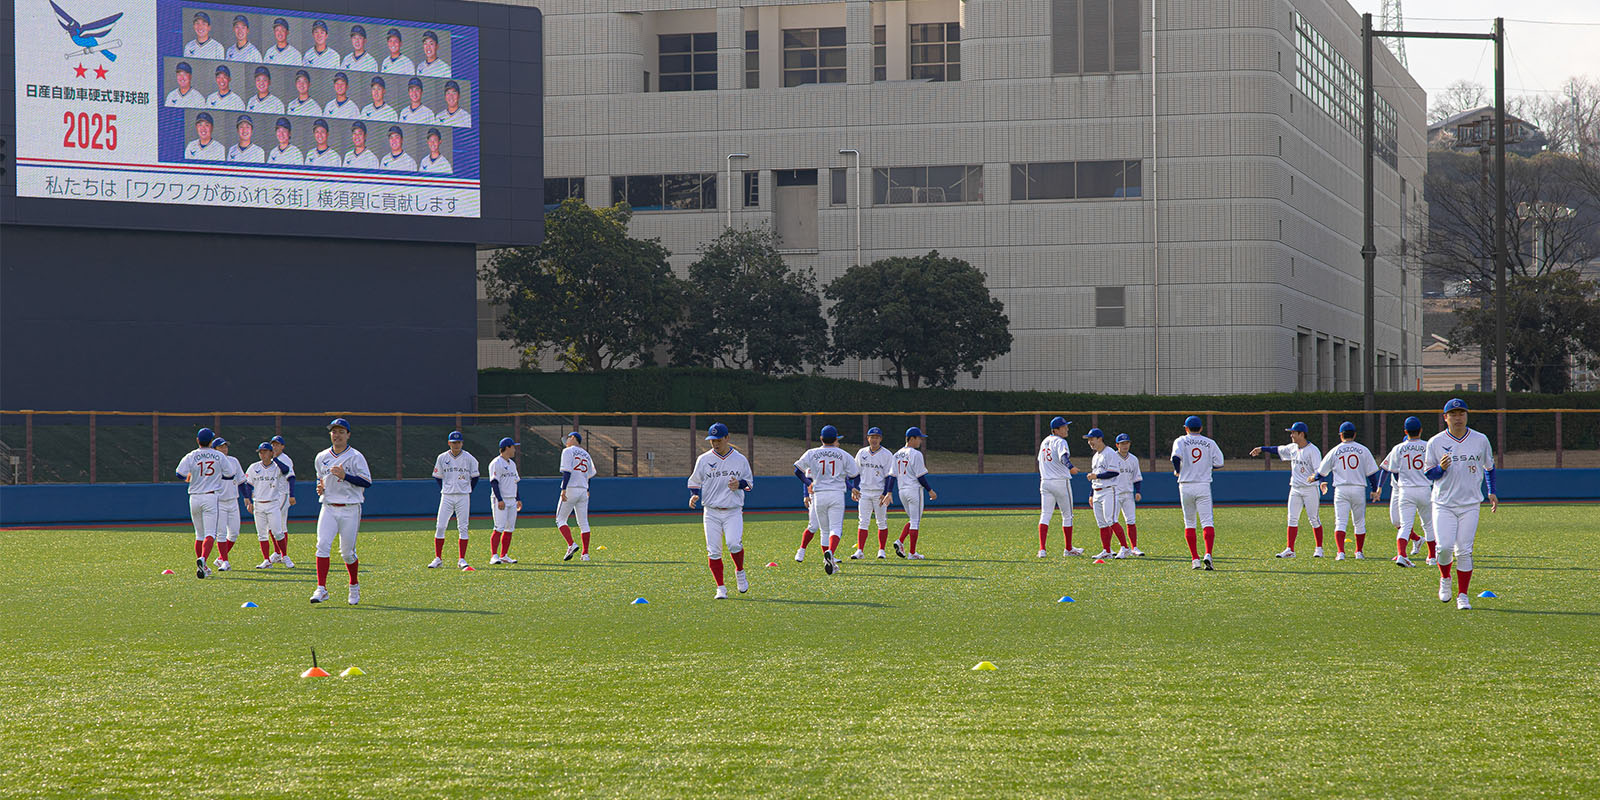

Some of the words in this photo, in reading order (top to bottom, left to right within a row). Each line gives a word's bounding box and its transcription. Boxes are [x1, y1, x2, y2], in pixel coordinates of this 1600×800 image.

[26, 84, 149, 104] 日産自動車硬式野球部
[63, 111, 117, 151] 2025
[45, 175, 459, 213] 私たちは「ワクワクがあふれる街」横須賀に貢献します
[194, 452, 220, 462] TOMONO
[1042, 448, 1053, 462] 18
[1191, 447, 1202, 464] 9
[1339, 454, 1359, 470] 10
[1403, 454, 1424, 470] 16
[1452, 454, 1481, 462] SSAN
[197, 461, 215, 476] 13
[573, 456, 588, 472] 25
[819, 460, 835, 476] 11
[897, 460, 908, 475] 17
[706, 470, 741, 479] NISSAN
